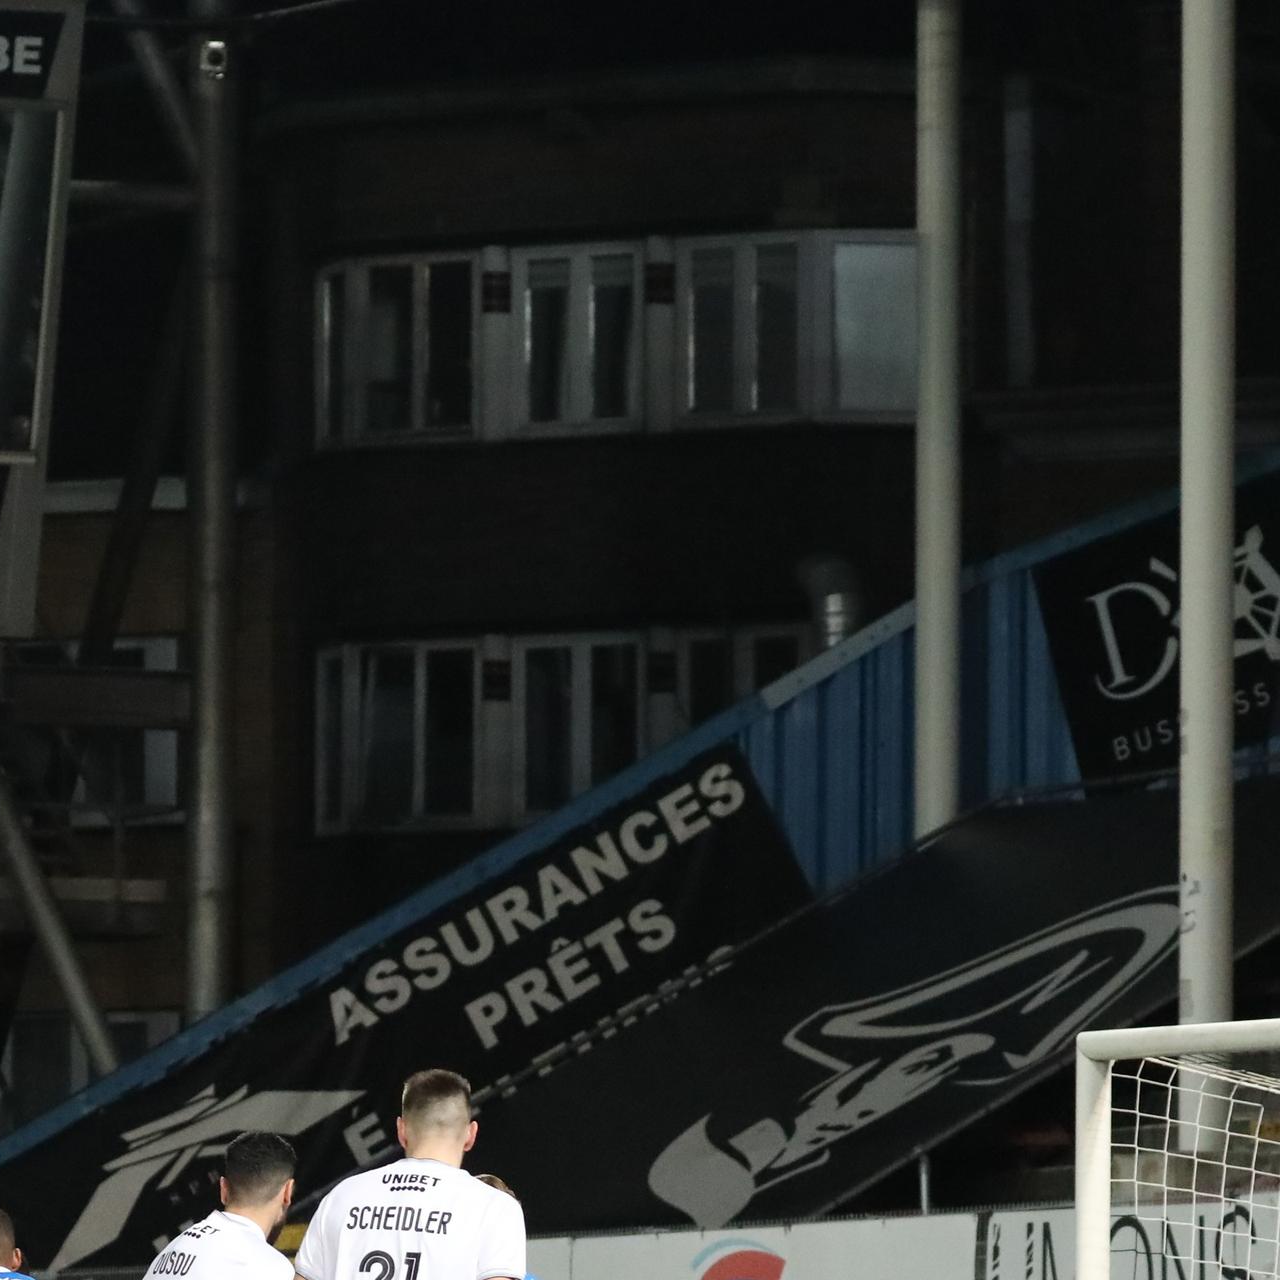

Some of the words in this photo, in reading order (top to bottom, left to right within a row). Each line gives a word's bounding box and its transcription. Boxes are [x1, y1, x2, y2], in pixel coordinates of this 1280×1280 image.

[1112, 681, 1272, 762] BUSSS
[328, 761, 746, 1046] ASSURANCES
[463, 897, 677, 1050] PRÊTS
[347, 1206, 452, 1236] SCHEIDLER
[382, 1173, 442, 1188] UNIBET
